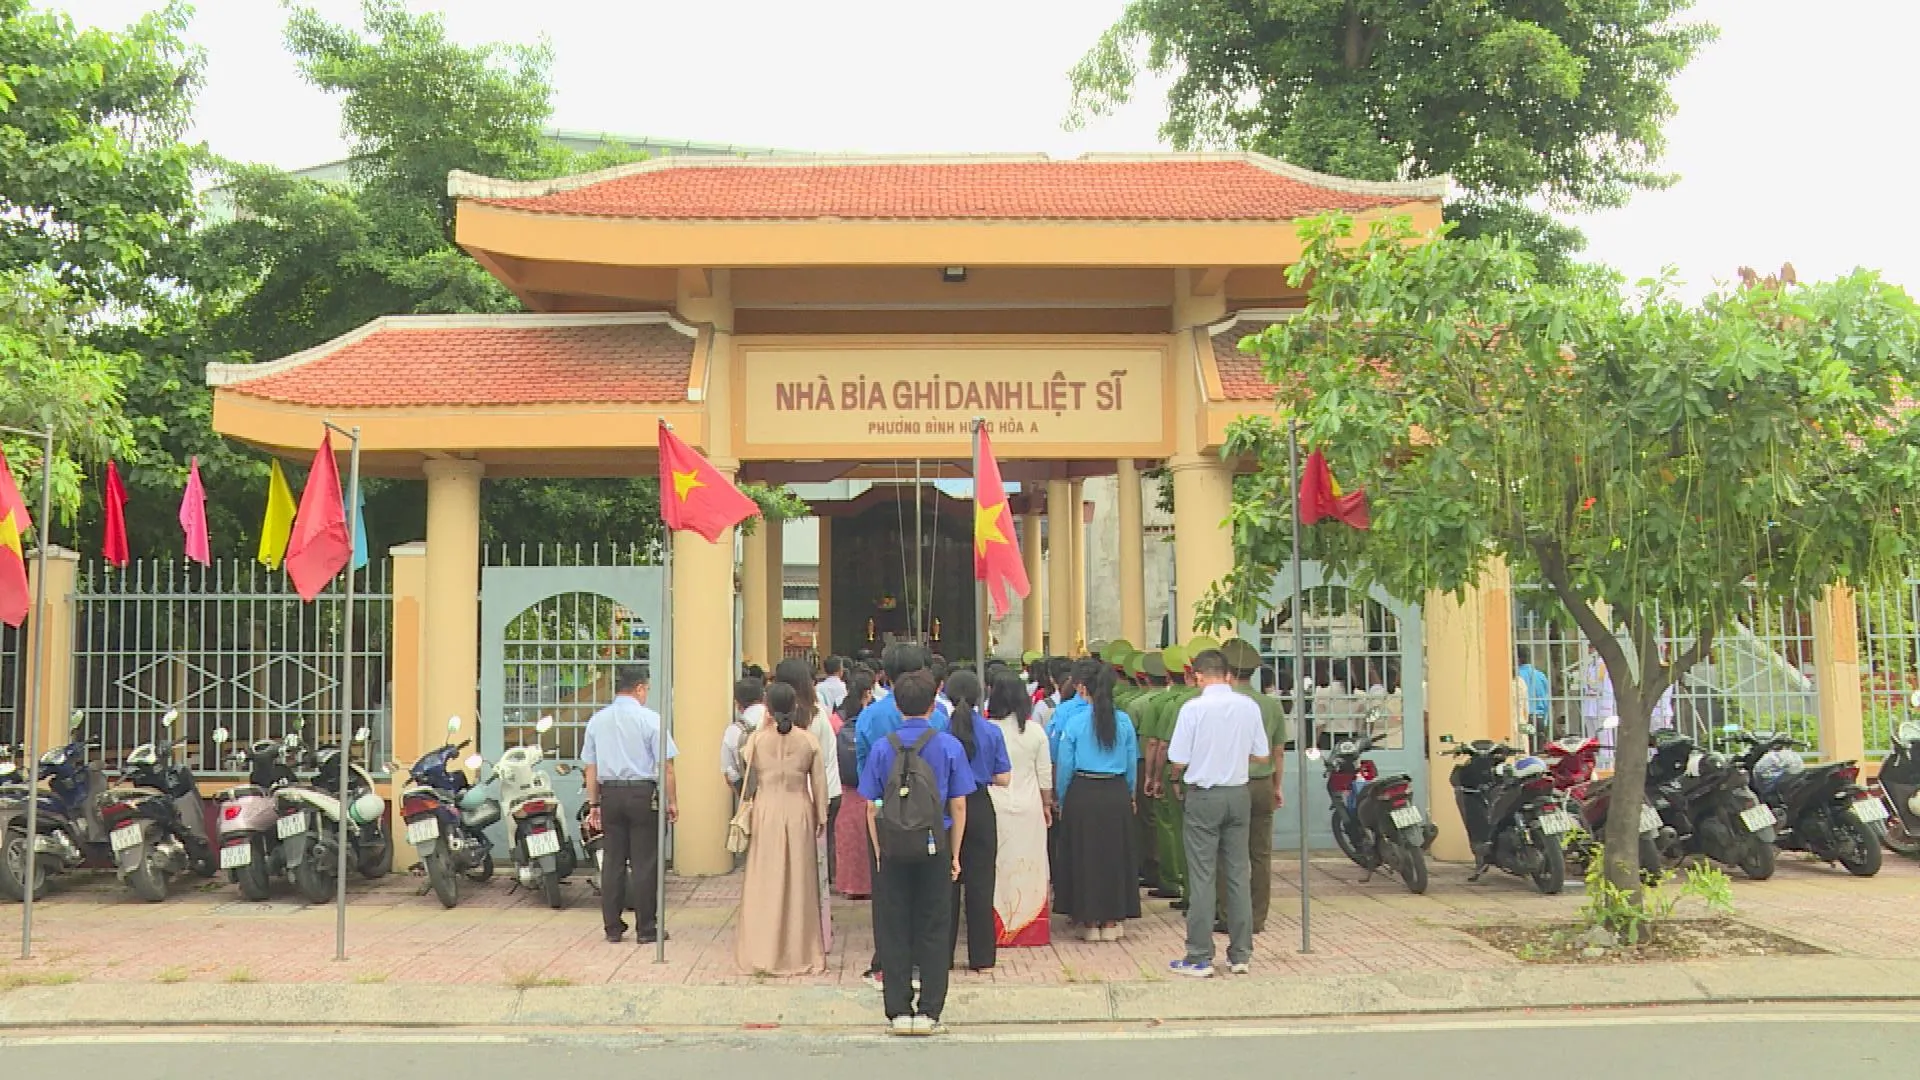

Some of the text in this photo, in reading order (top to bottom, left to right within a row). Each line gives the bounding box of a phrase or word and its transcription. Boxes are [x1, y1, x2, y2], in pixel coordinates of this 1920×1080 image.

[776, 373, 836, 411] NHÀ
[944, 380, 1023, 411] DANH
[1027, 369, 1087, 417] LIỆT
[1096, 369, 1128, 411] SĨ
[999, 416, 1025, 433] HÒA
[1030, 420, 1039, 433] A
